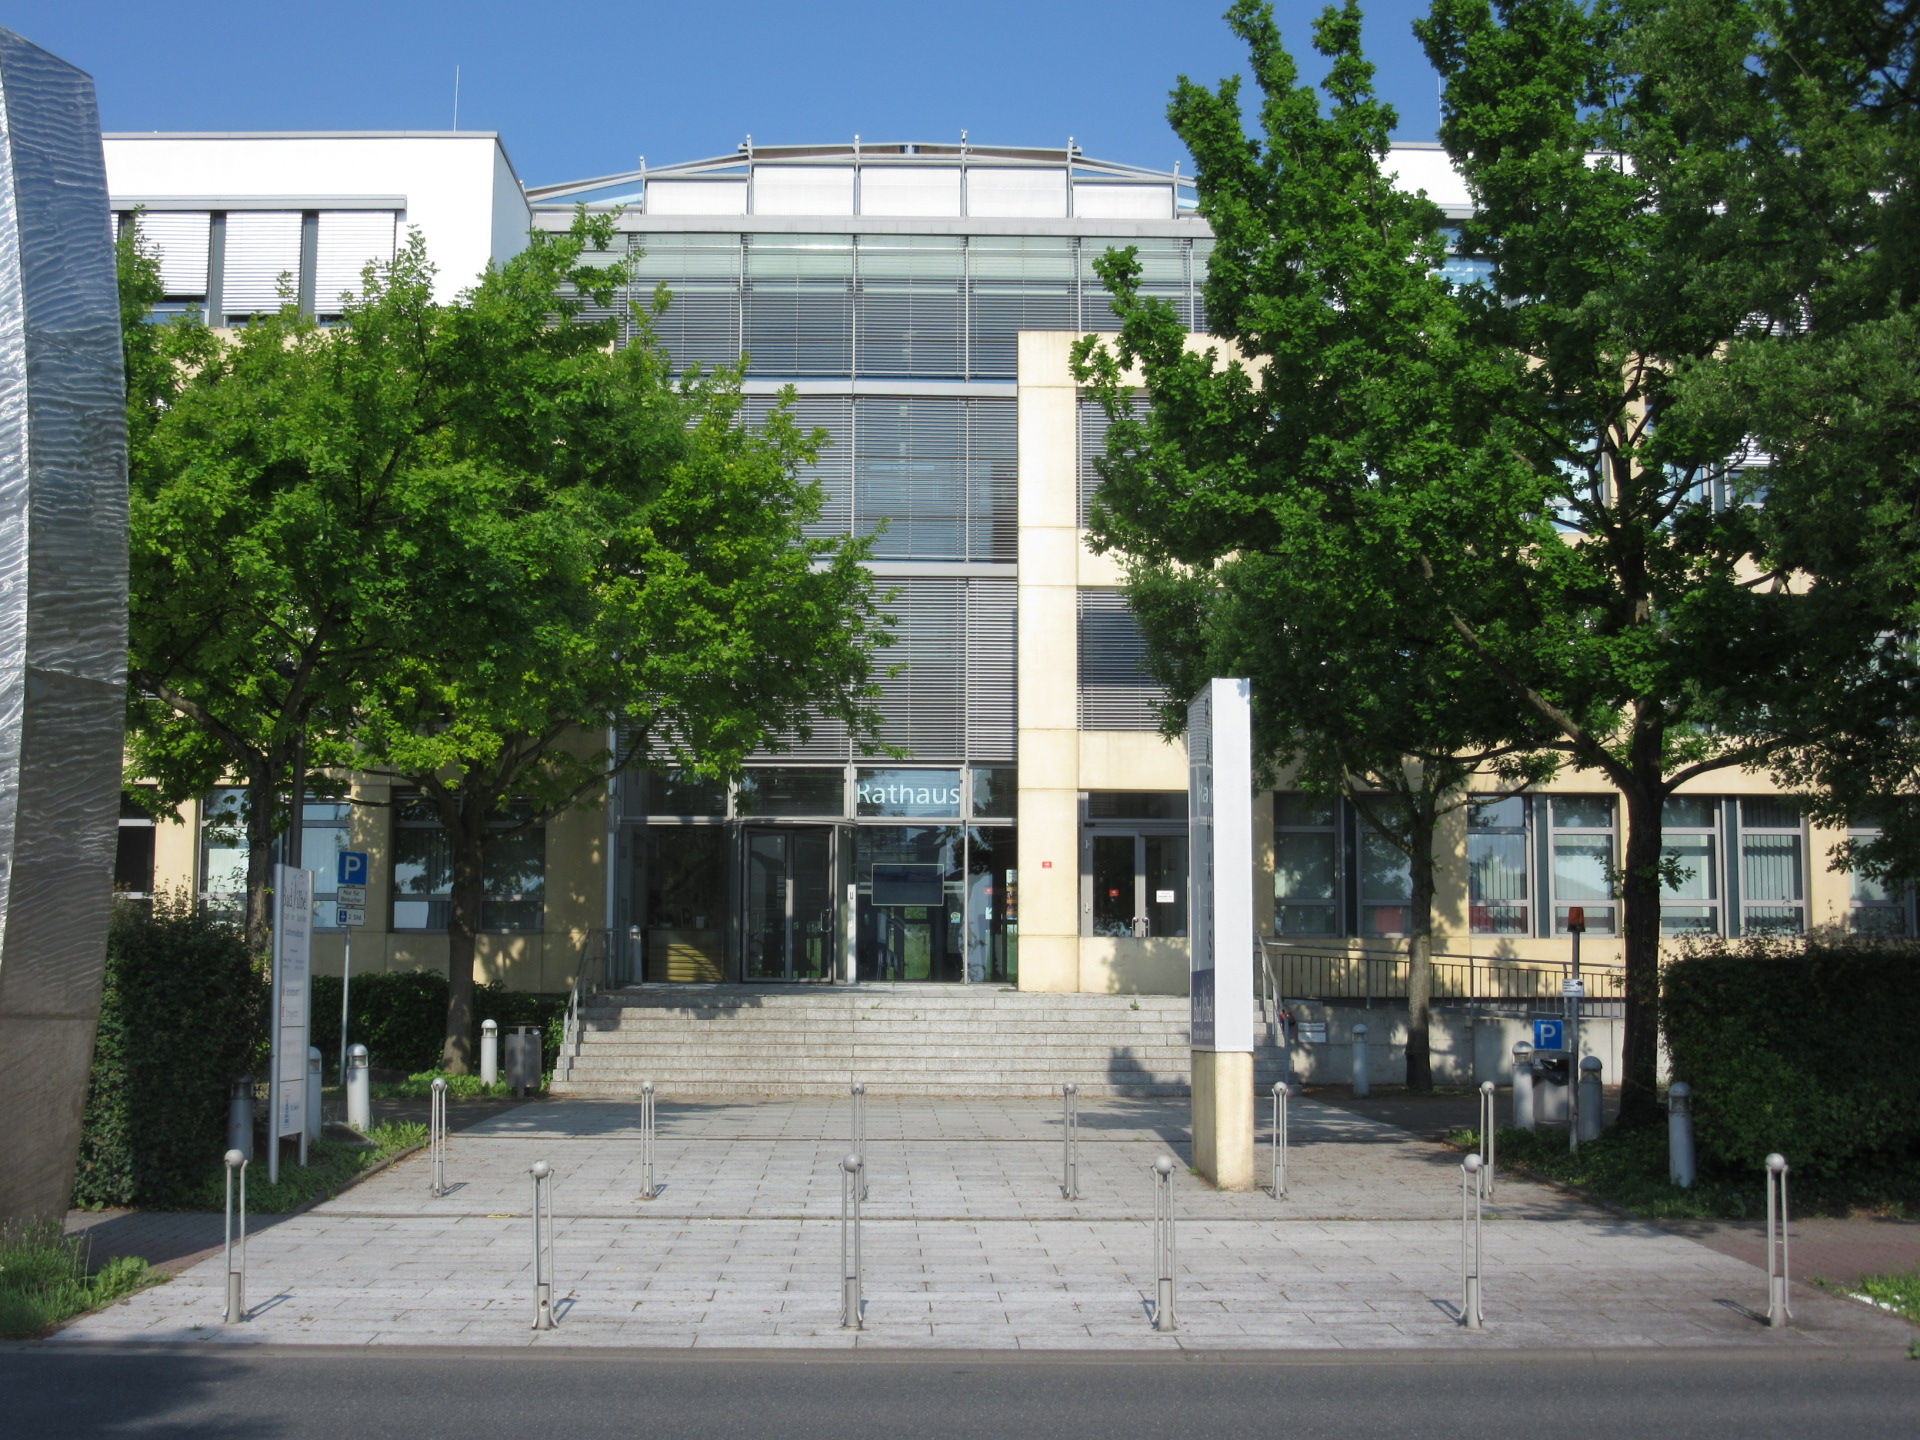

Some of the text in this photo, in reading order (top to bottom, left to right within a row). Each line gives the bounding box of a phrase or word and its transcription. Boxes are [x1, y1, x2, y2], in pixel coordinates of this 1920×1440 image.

[856, 783, 960, 804] Rathaus
[344, 855, 361, 880] P
[1541, 1024, 1556, 1046] P
